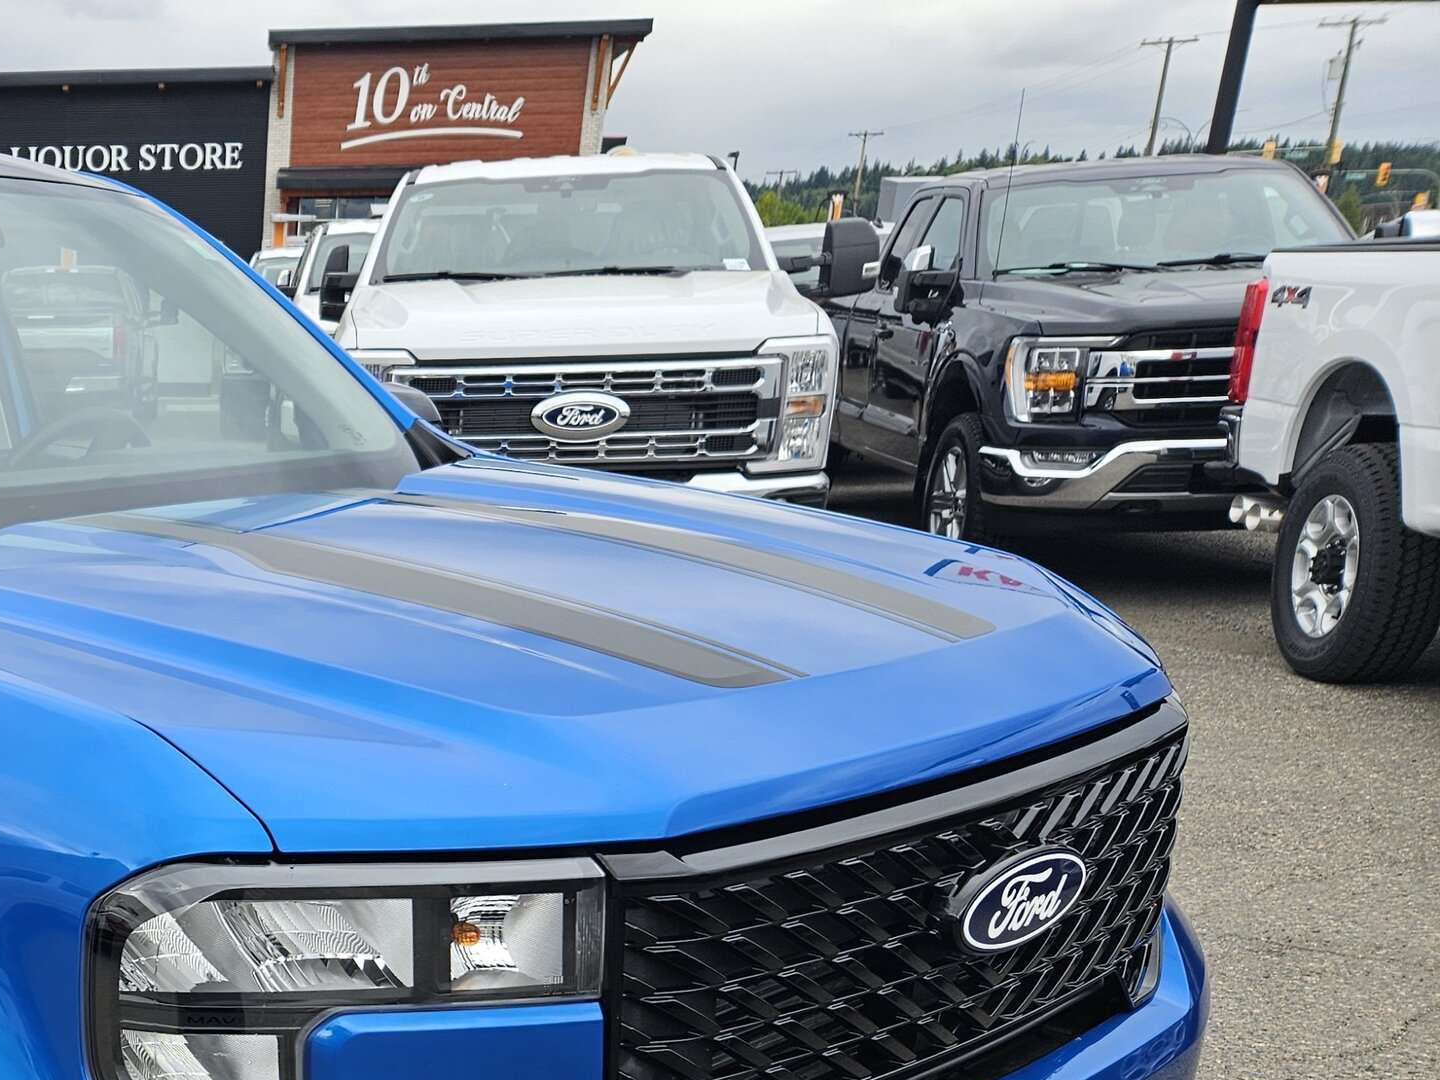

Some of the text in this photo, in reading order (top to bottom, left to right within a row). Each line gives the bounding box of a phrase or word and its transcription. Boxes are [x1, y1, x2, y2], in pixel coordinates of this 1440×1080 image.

[410, 103, 438, 123] on
[440, 84, 526, 124] Central
[138, 142, 244, 171] STORE
[556, 405, 605, 426] Ford
[988, 867, 1068, 939] Ford
